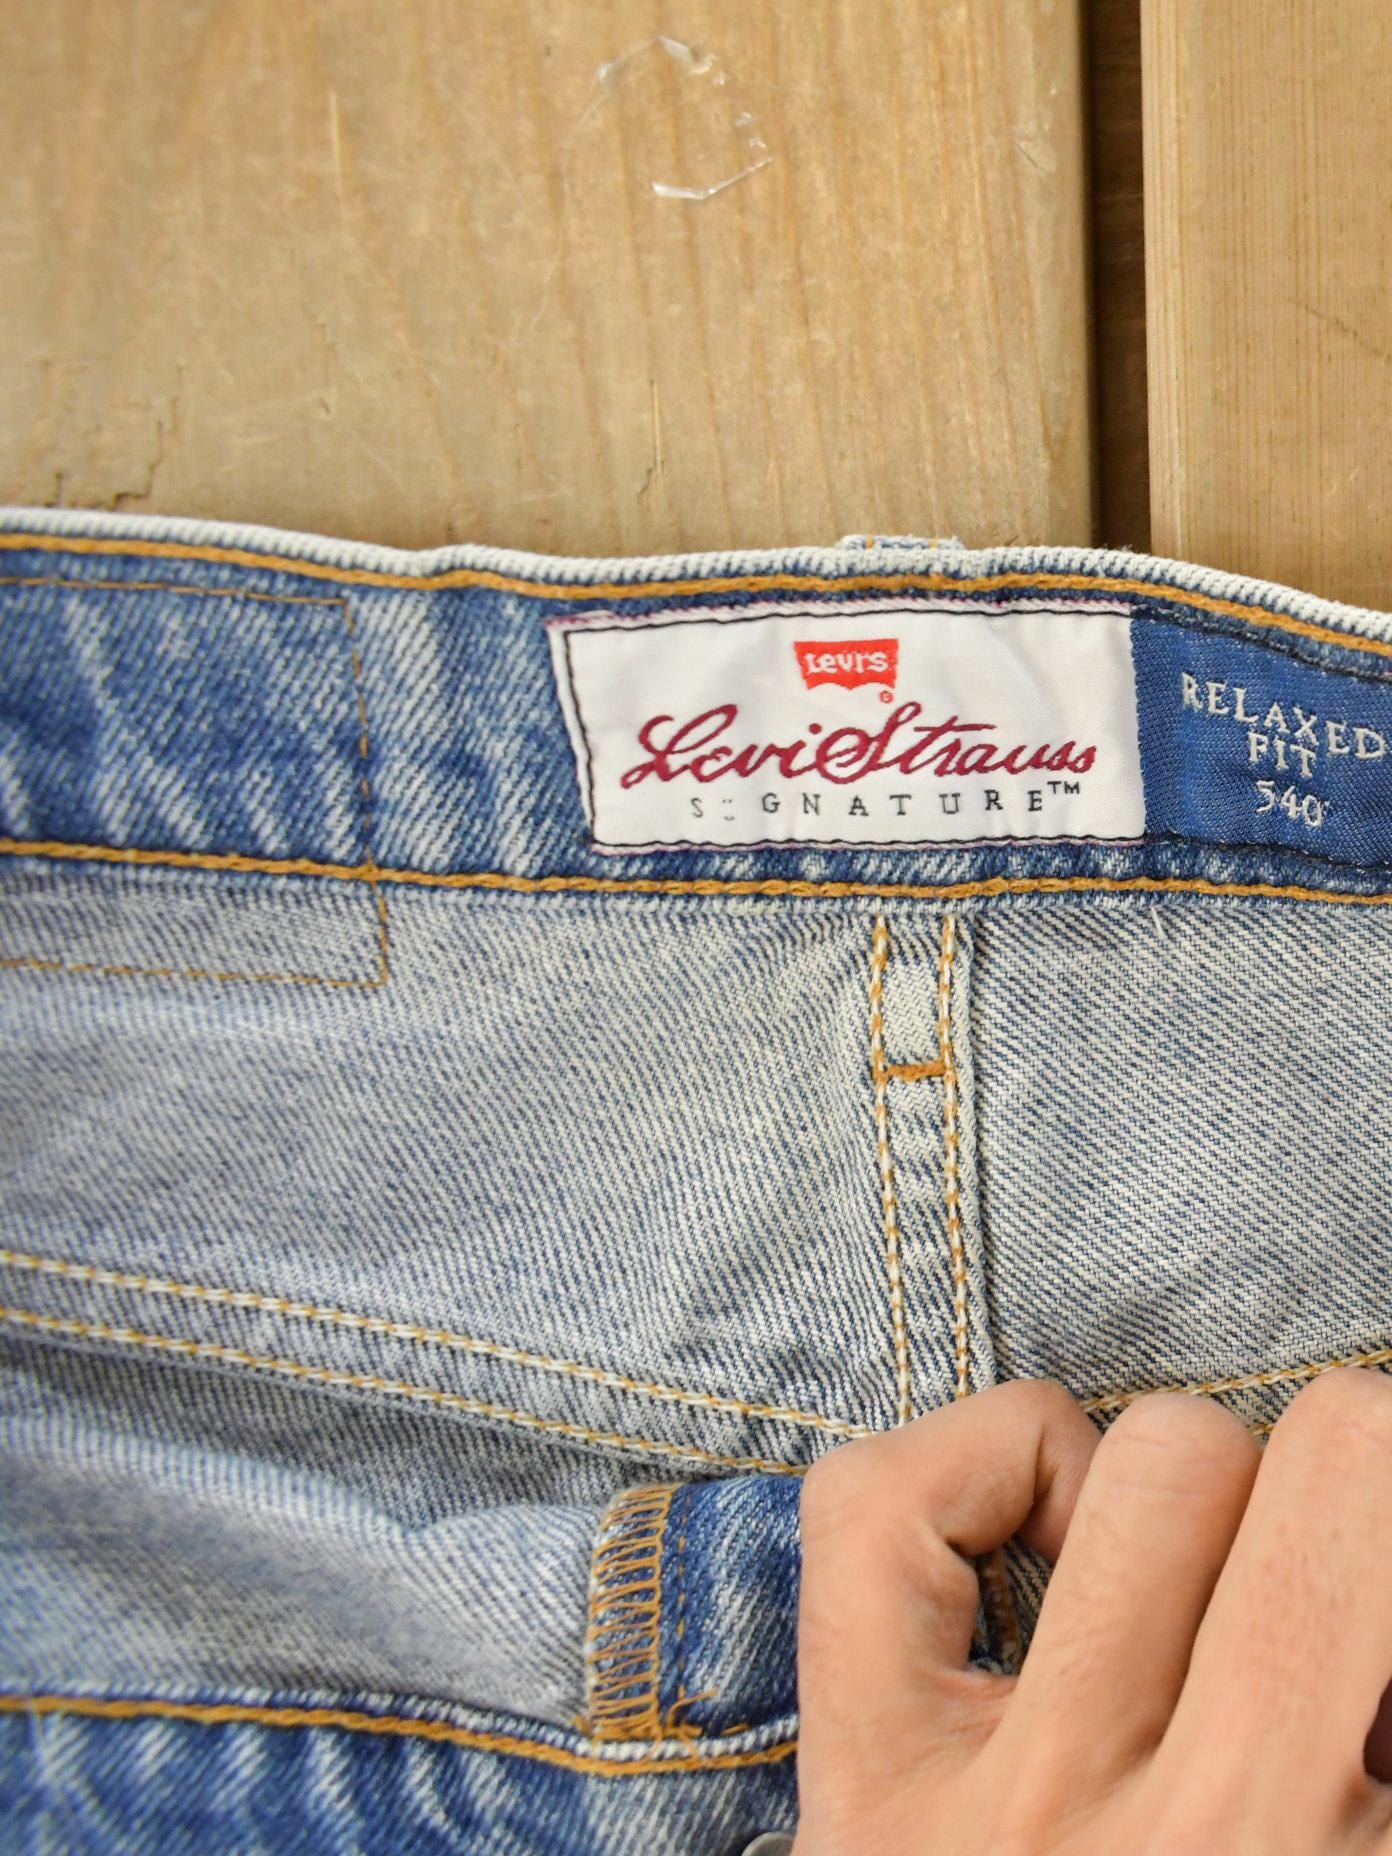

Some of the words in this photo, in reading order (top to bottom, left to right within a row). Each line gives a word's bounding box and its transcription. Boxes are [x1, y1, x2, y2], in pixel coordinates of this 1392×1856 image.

[620, 703, 821, 790] Levi
[816, 701, 1097, 785] Strauss
[1181, 671, 1387, 760] RELAXED
[1248, 731, 1318, 778] FIT
